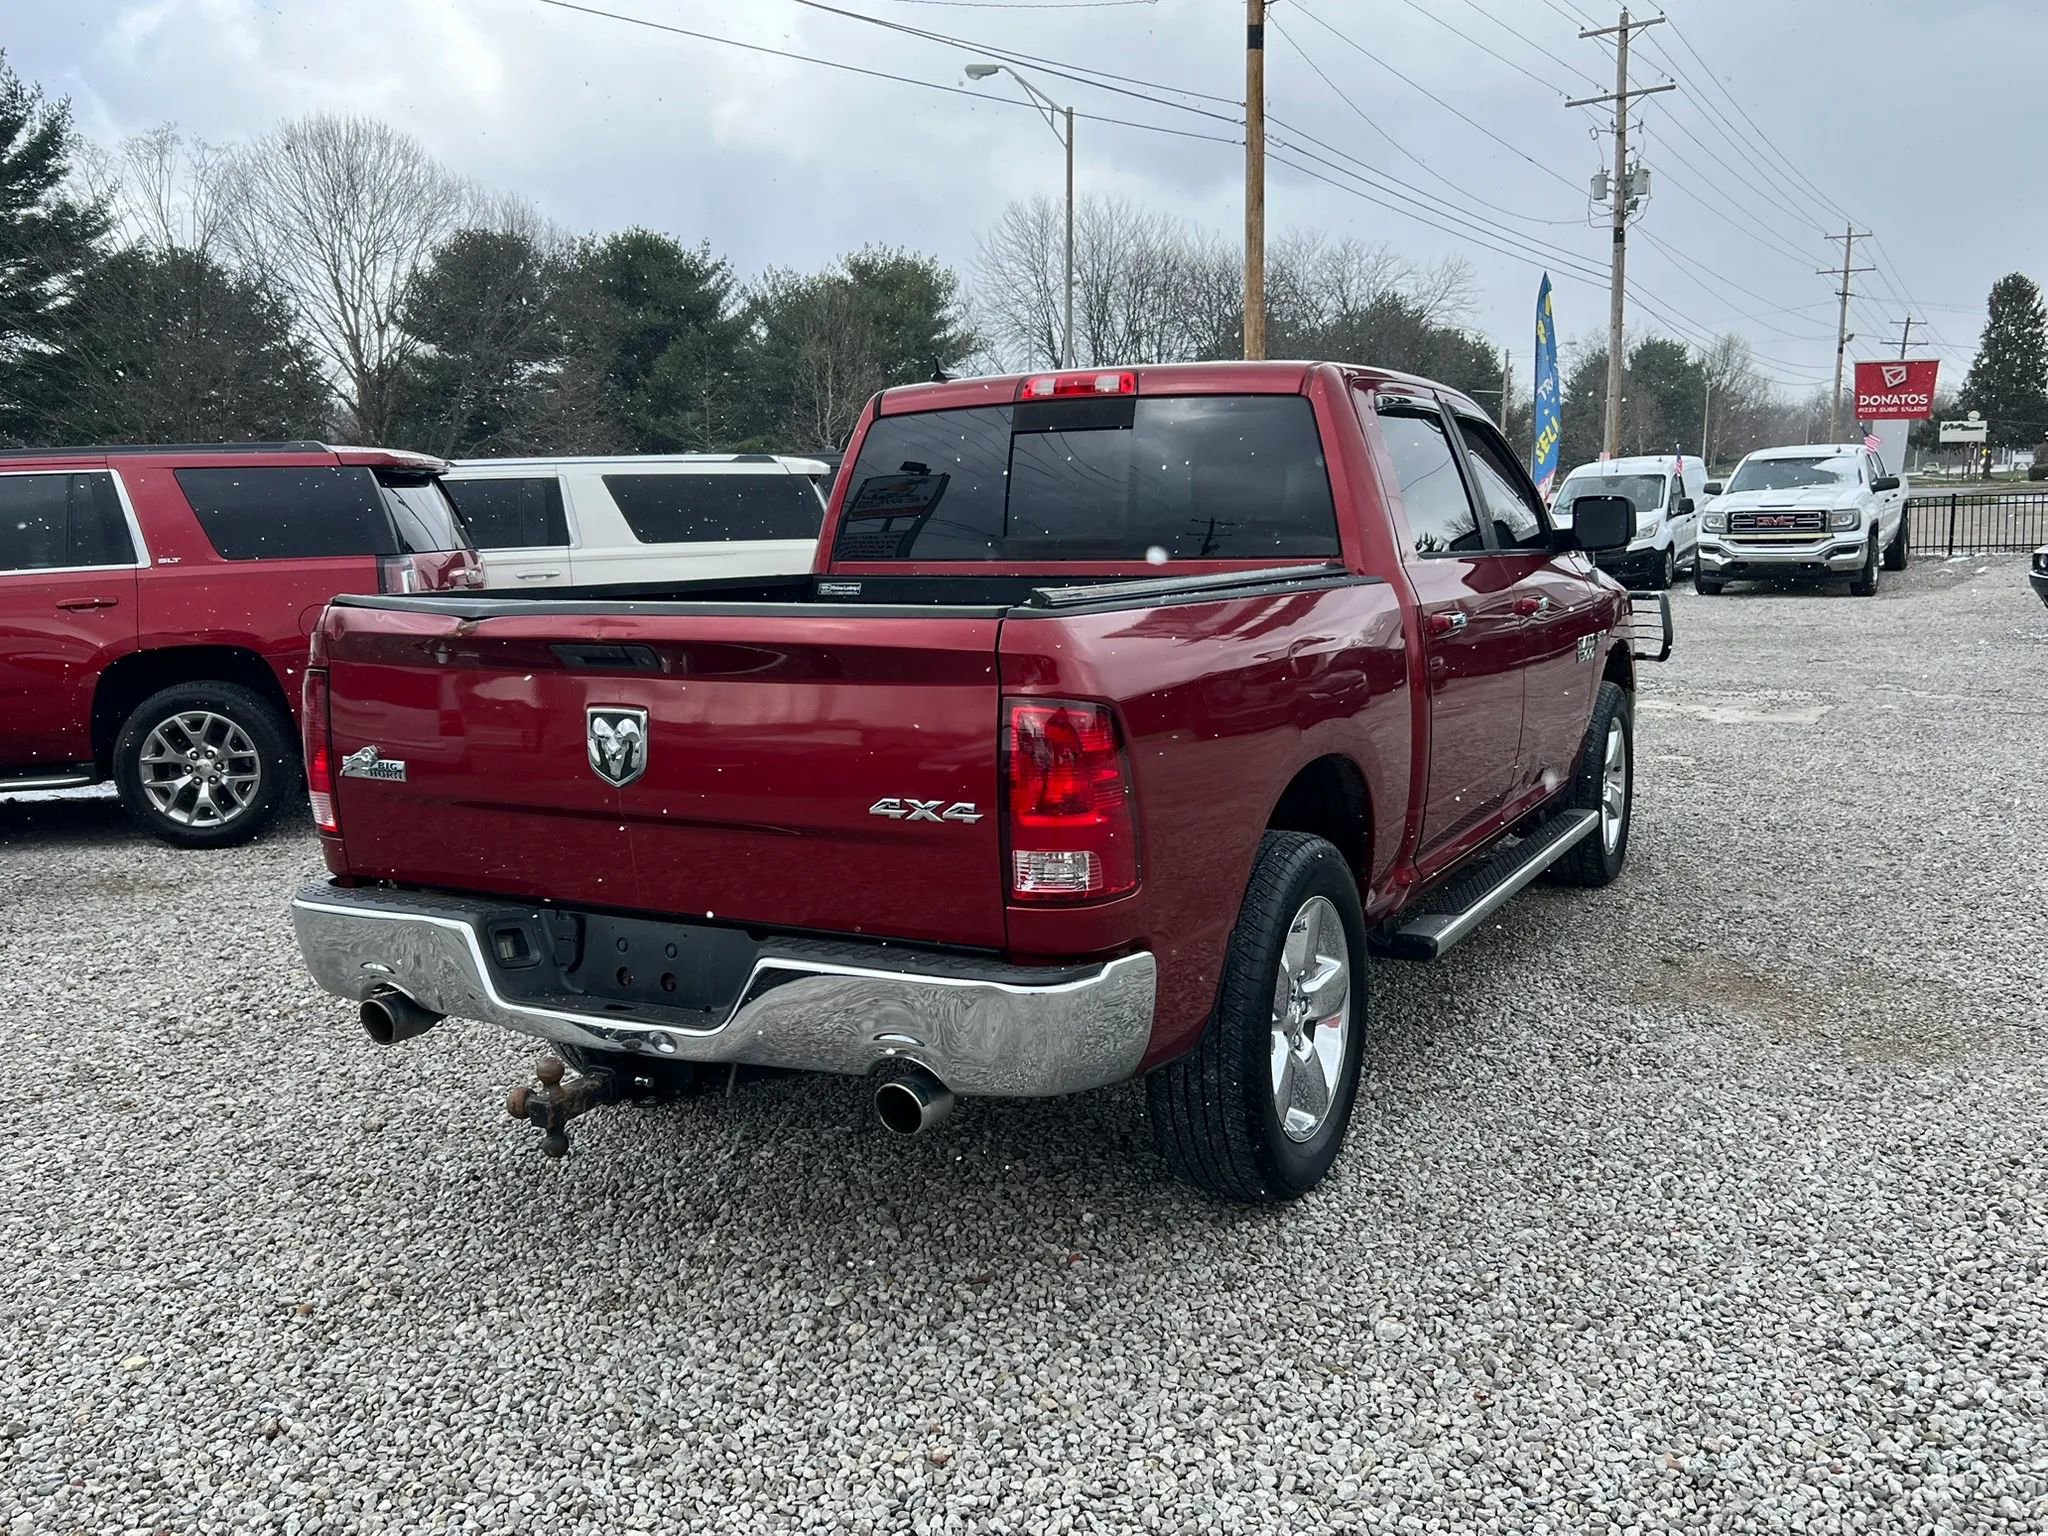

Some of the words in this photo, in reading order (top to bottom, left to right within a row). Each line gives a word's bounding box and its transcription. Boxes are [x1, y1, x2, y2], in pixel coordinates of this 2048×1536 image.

[1859, 394, 1928, 406] DONATOS
[1756, 515, 1796, 527] GMC
[378, 762, 398, 771] BIG
[369, 769, 403, 780] HORN
[869, 797, 984, 824] 4X4
